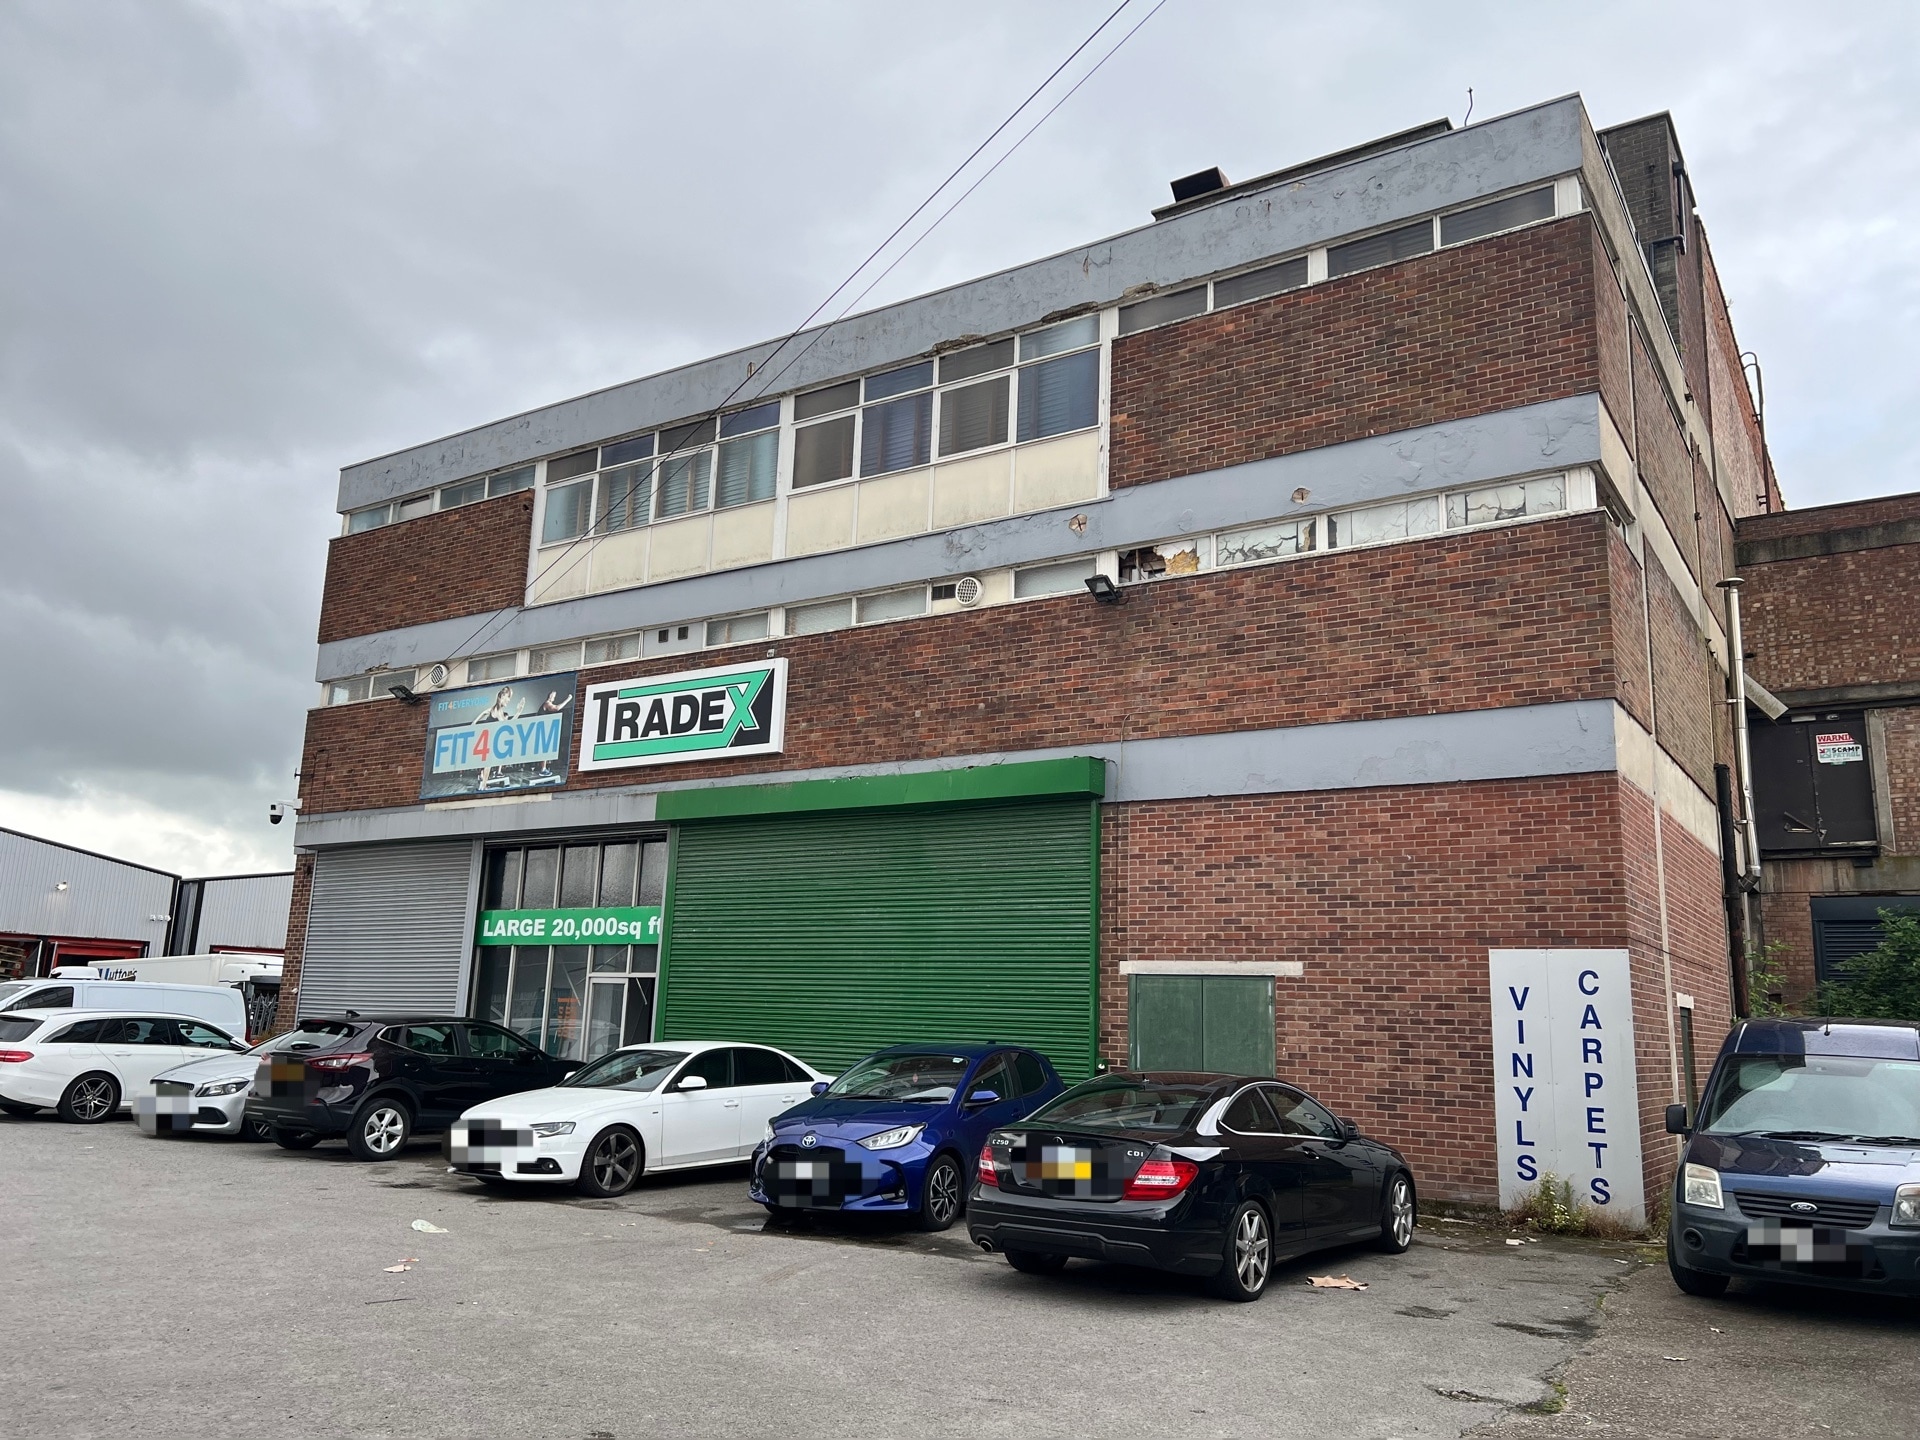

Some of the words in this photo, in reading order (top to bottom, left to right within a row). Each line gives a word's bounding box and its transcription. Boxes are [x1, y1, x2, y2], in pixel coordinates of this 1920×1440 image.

[592, 681, 758, 743] TRADEX
[1831, 746, 1860, 754] SCAMP
[483, 918, 545, 937] LARGE
[551, 917, 642, 940] 20,000sq
[1509, 987, 1538, 1181] VINYLS
[1578, 970, 1611, 1205] CARPETS
